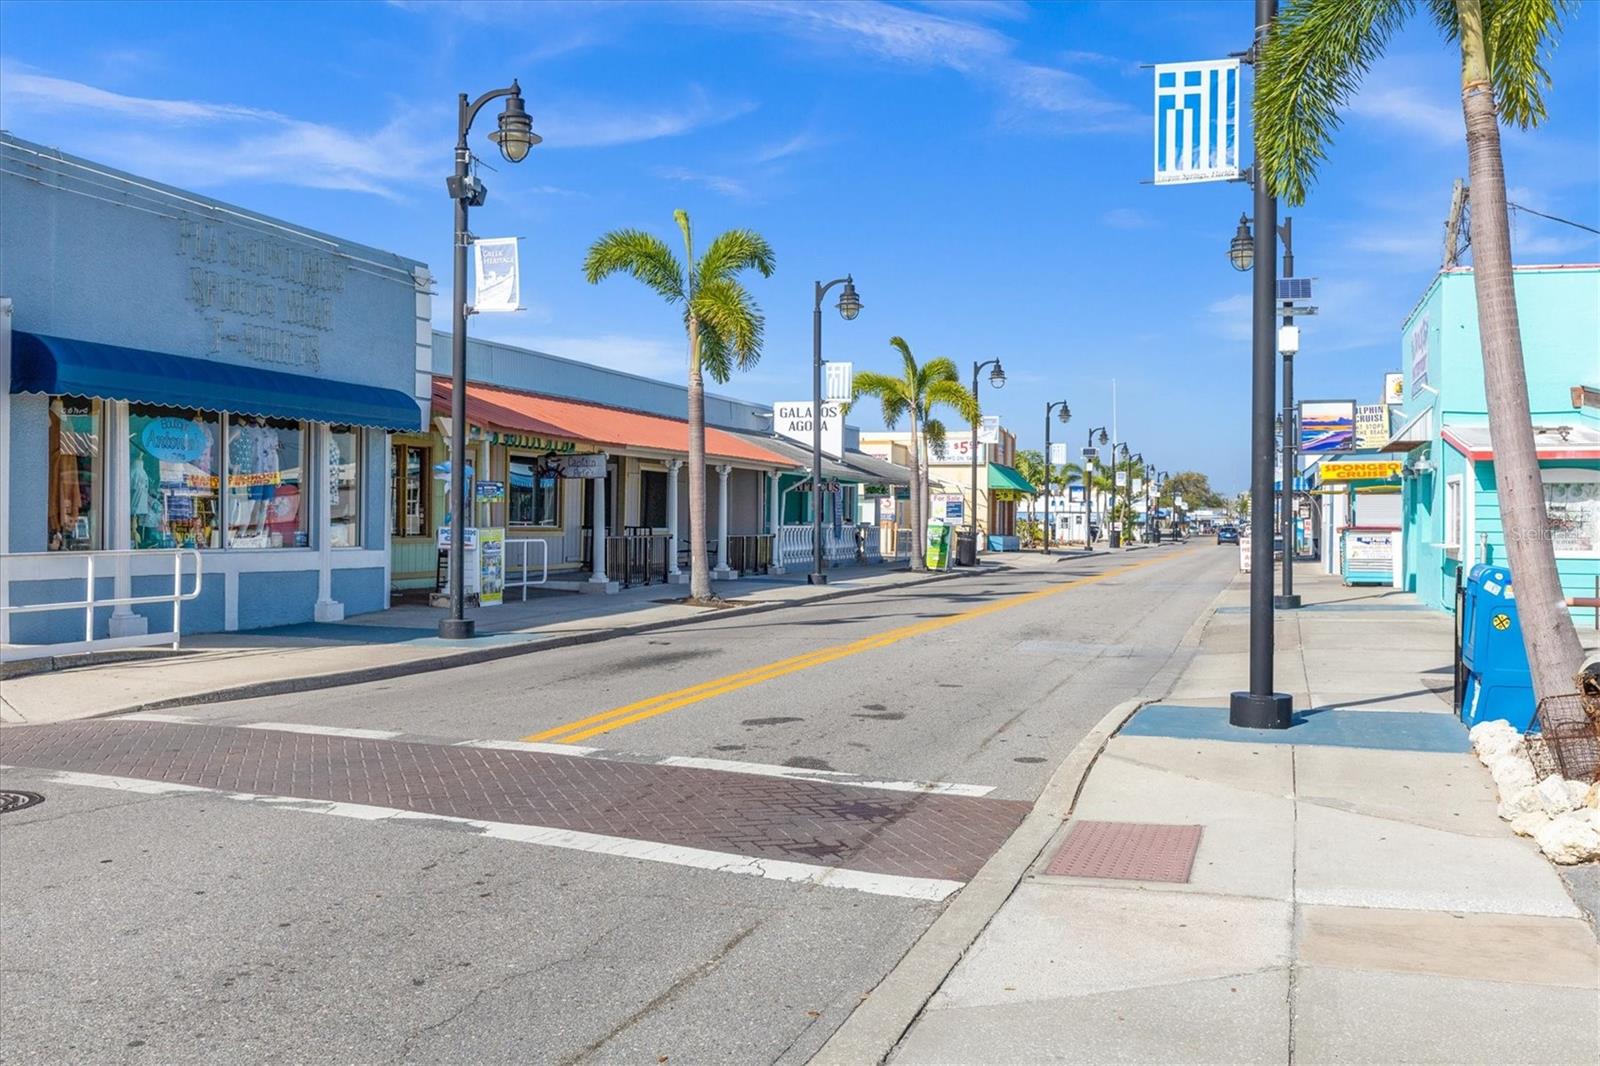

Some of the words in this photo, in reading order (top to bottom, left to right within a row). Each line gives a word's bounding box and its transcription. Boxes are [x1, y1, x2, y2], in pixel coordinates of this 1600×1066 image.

[779, 406, 838, 418] GALAOS
[788, 420, 829, 431] AGOA
[1325, 463, 1402, 472] SPONGEO
[1336, 470, 1388, 478] CRUISE
[795, 482, 840, 493] ATTCUS
